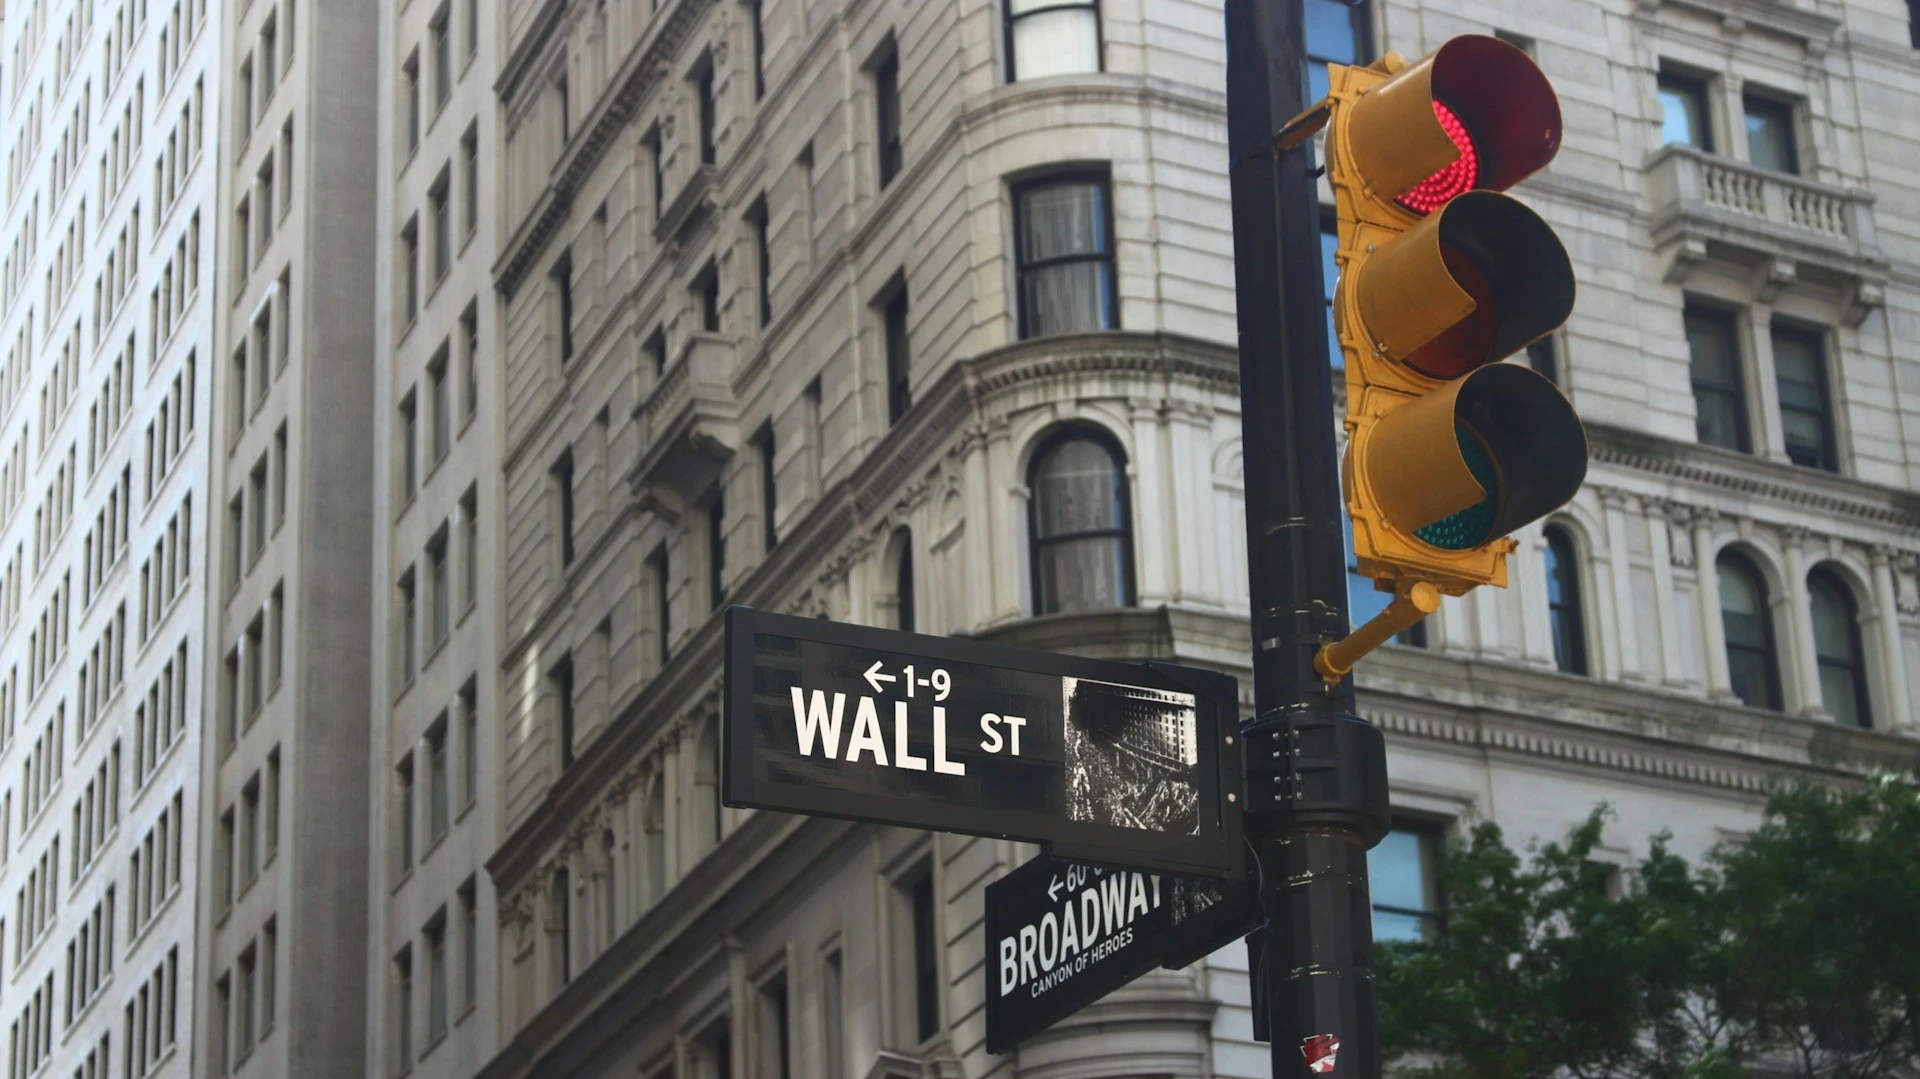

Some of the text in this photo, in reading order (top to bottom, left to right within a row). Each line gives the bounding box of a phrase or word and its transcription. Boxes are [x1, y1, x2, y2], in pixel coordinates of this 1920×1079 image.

[902, 664, 951, 702] 1-9
[790, 686, 1027, 776] WALL ST
[1031, 927, 1134, 998] CANYON OF HEROES
